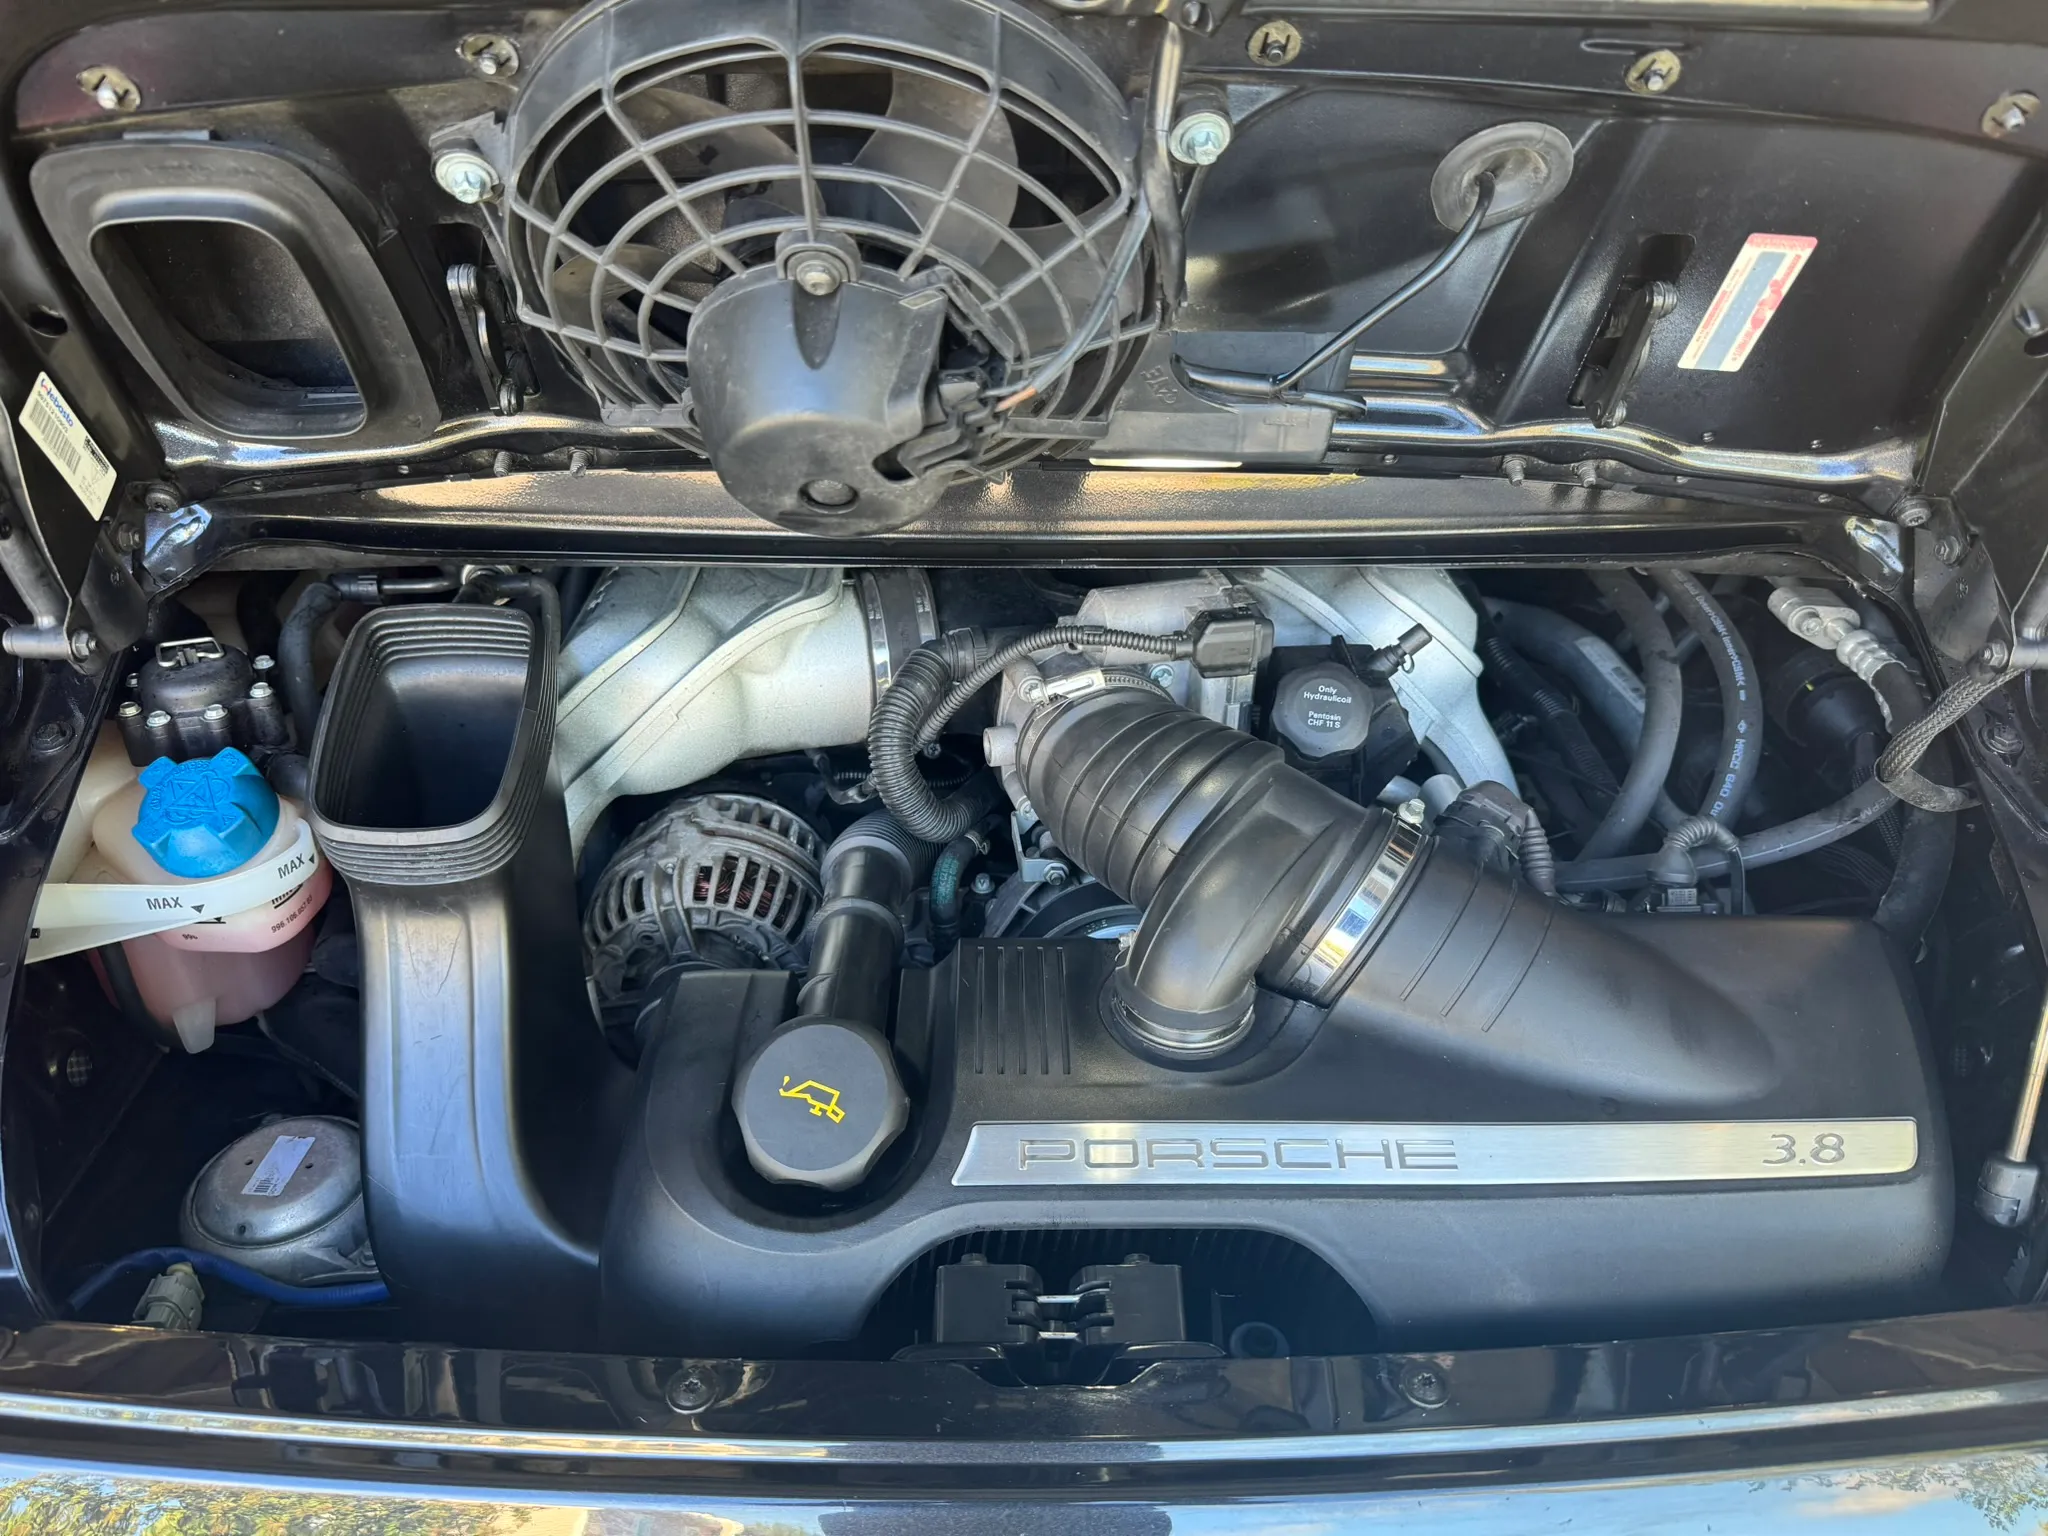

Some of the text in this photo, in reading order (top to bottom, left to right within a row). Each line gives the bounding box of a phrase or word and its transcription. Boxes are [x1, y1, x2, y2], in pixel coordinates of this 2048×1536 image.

[40, 378, 74, 427] Webasto
[1318, 685, 1337, 695] Only
[1303, 691, 1352, 704] Hydraulicoil
[1308, 710, 1342, 721] Pentosin
[1307, 719, 1341, 729] CHF 11 S
[277, 853, 305, 879] MAX
[146, 896, 184, 910] MAX
[1018, 1133, 1845, 1171] PORSCHE 3.8
